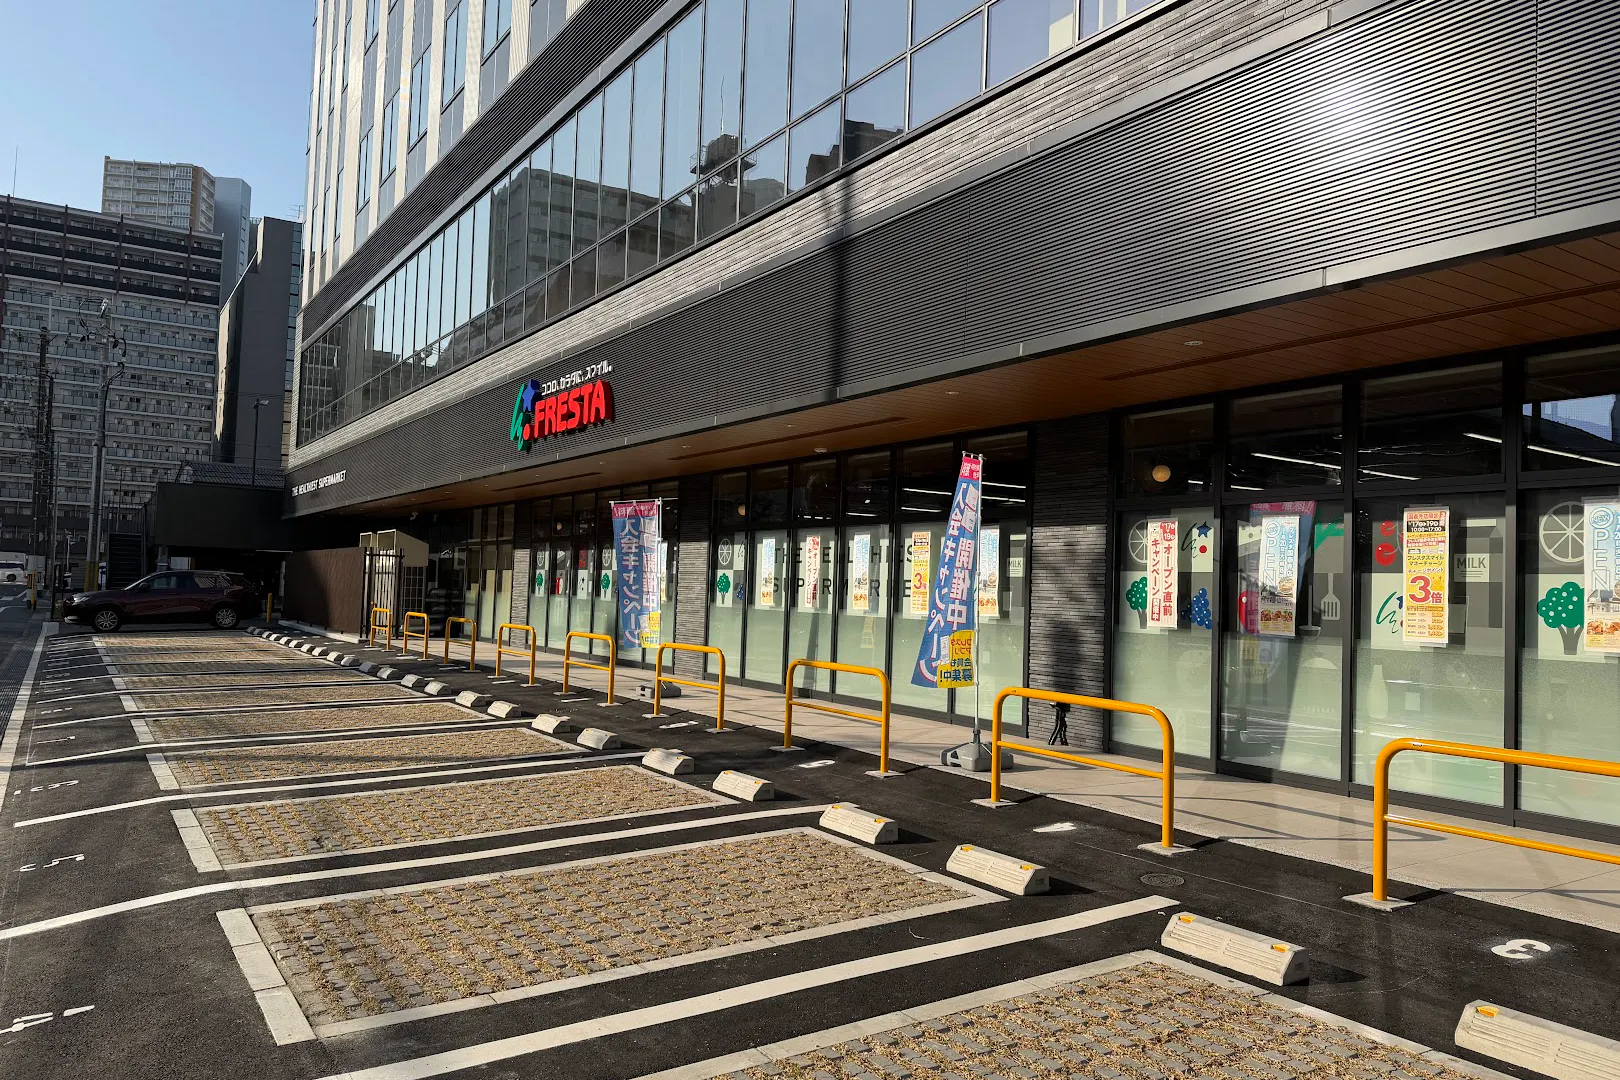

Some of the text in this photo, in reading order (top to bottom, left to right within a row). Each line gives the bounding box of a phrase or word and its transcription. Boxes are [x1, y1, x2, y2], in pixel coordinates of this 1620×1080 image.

[534, 380, 607, 438] FRESTA
[1151, 538, 1161, 597] キャンペーン
[1163, 544, 1173, 617] オープン直前
[1456, 557, 1487, 569] MILK
[1409, 575, 1443, 604] 3倍
[1491, 939, 1552, 960] 3
